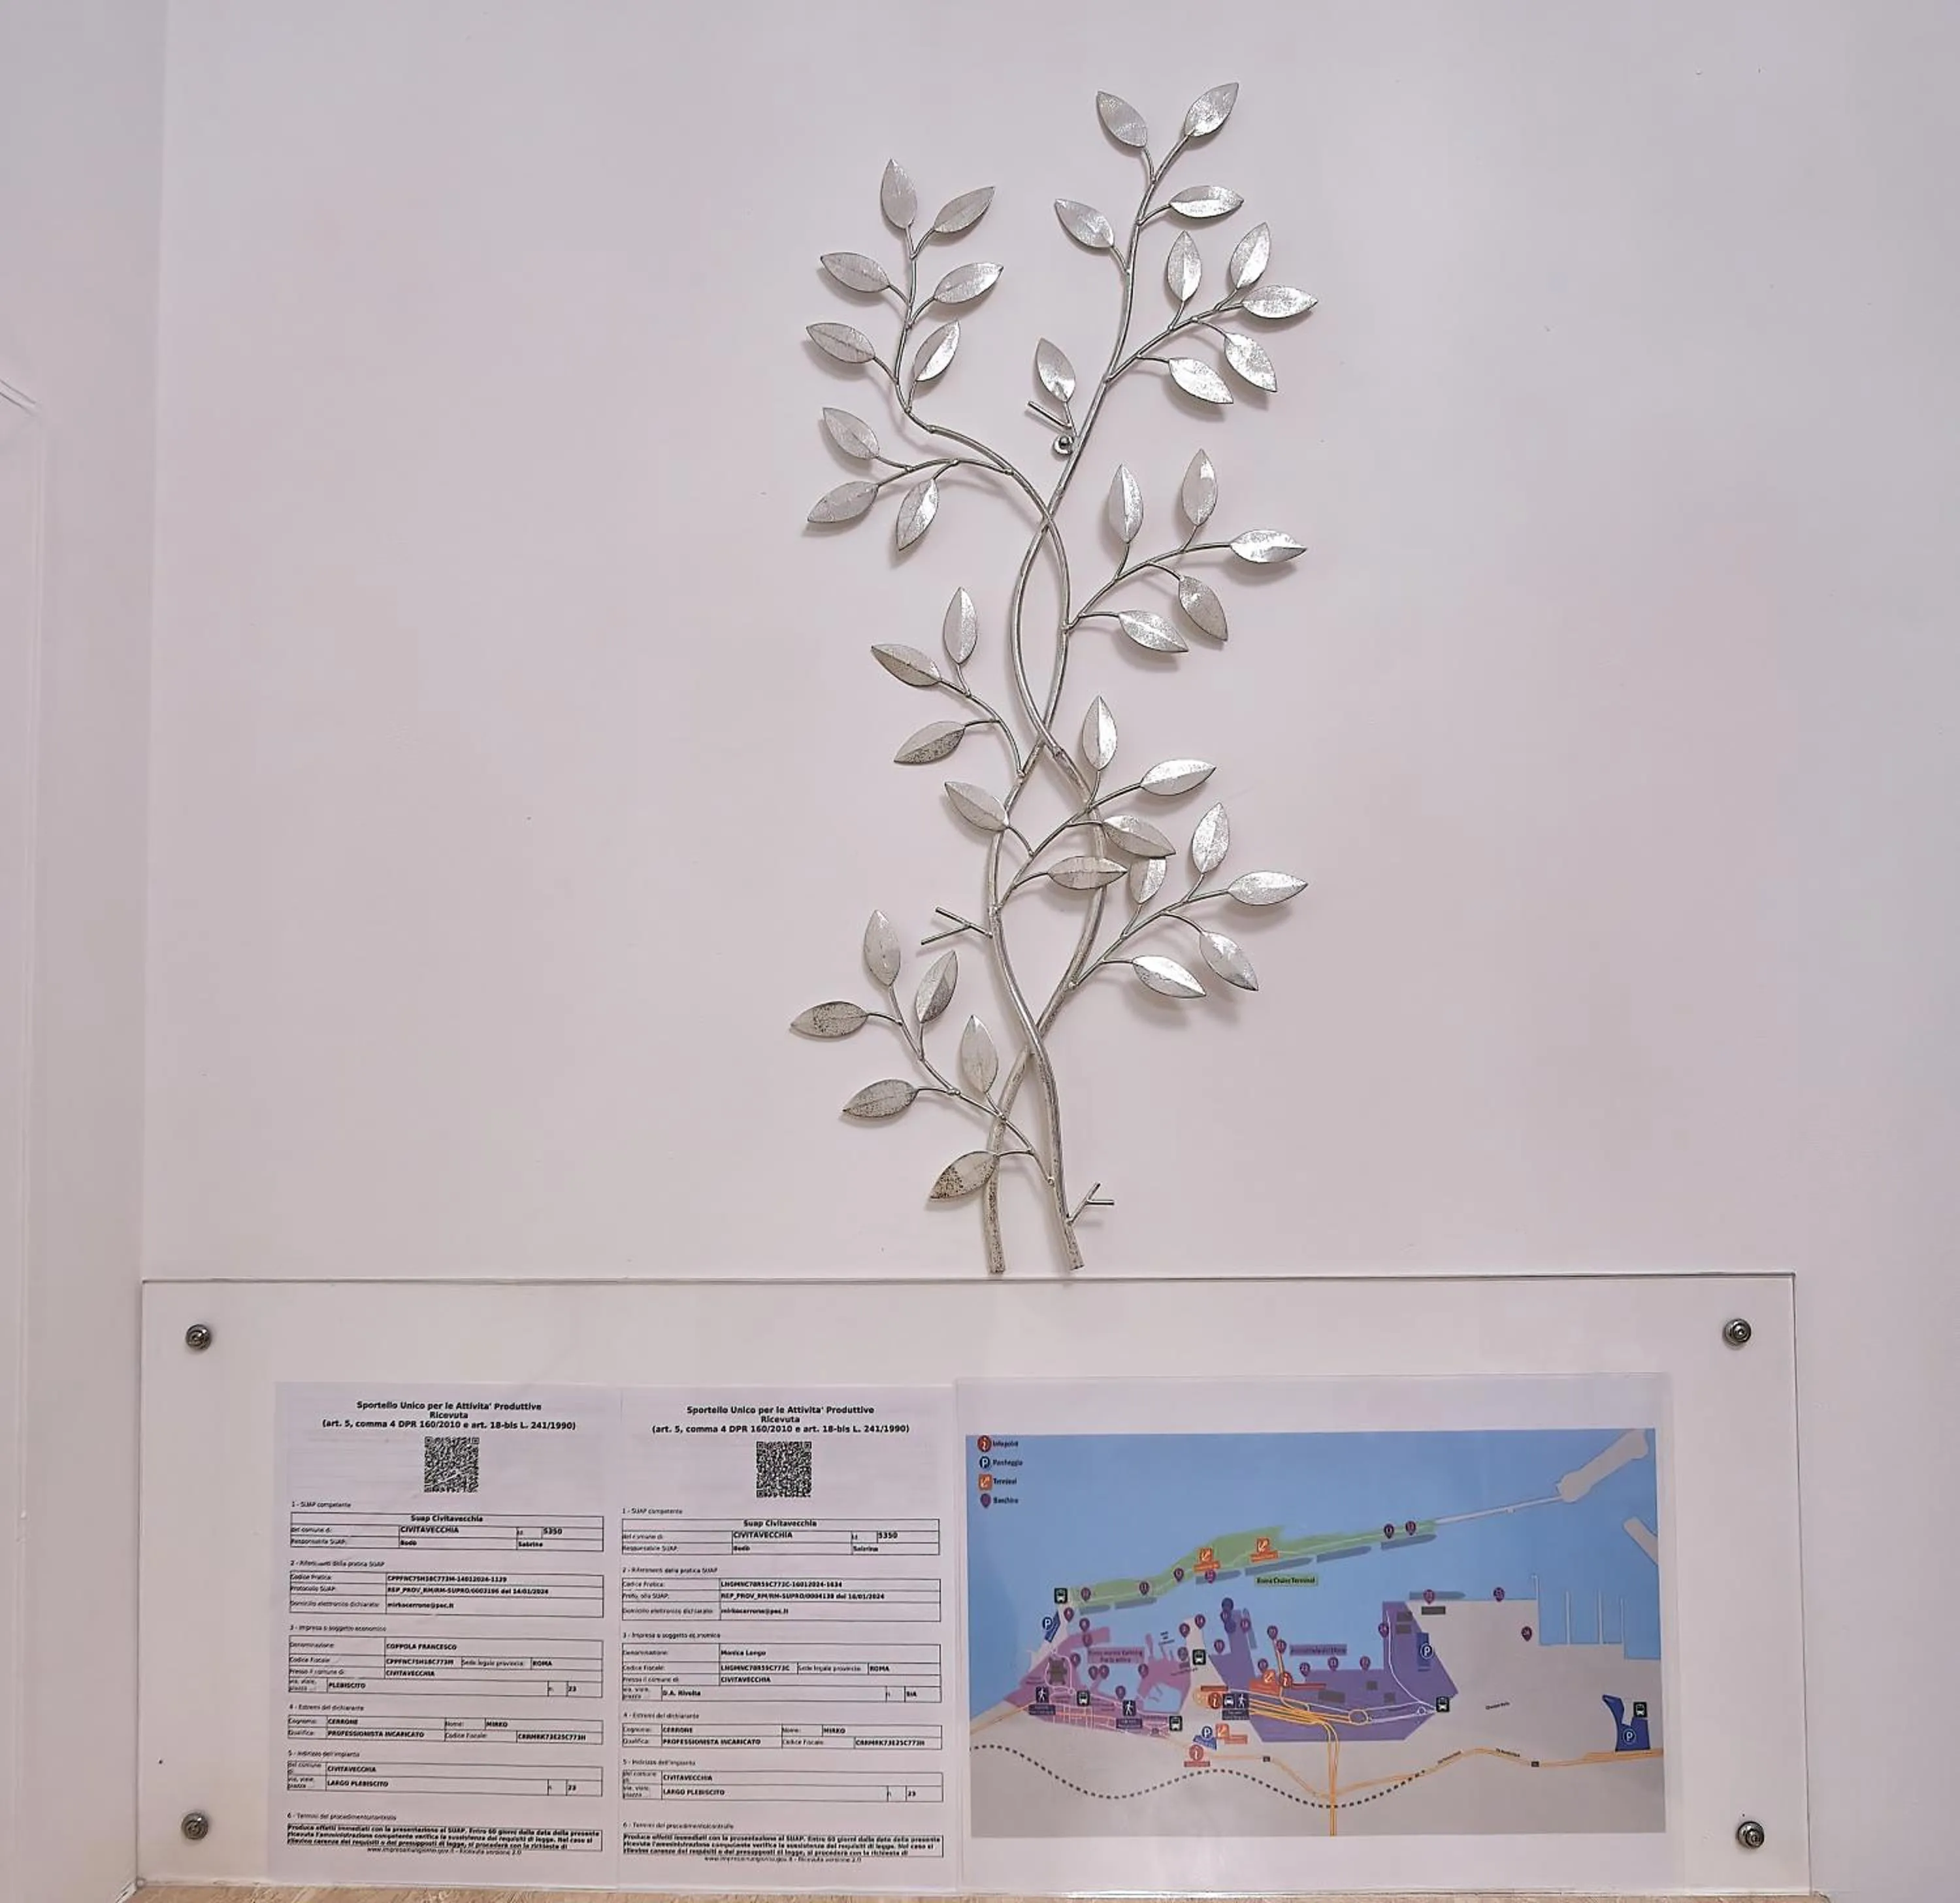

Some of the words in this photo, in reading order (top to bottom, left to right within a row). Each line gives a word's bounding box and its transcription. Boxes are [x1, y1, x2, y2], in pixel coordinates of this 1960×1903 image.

[357, 1401, 398, 1410] Sportello
[687, 1406, 728, 1415] Sportello
[323, 1419, 342, 1428] (art.
